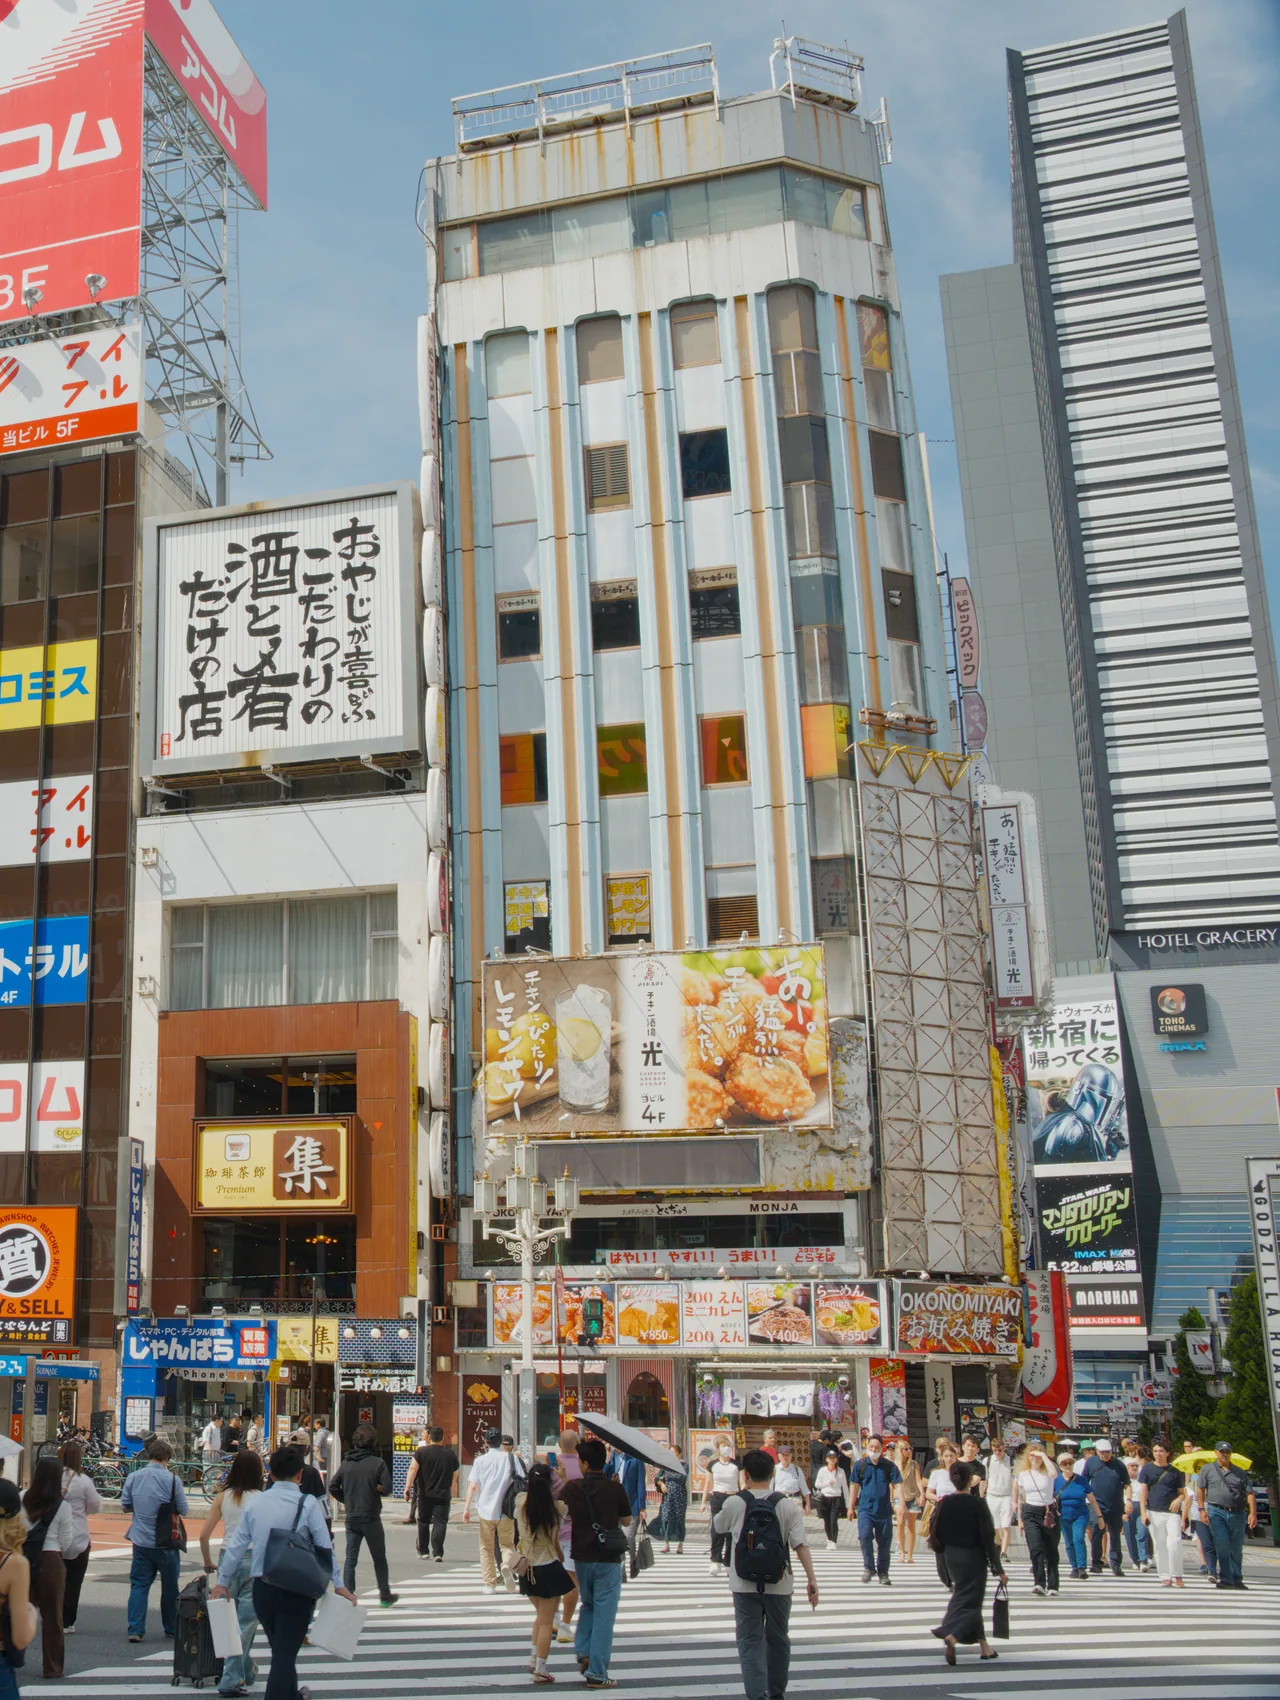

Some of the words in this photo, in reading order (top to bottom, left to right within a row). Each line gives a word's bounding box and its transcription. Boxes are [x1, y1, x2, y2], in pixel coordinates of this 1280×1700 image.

[181, 35, 238, 150] アコム
[61, 333, 127, 368] アイ
[61, 376, 129, 409] フル
[2, 423, 50, 448] 当ビル
[56, 418, 80, 440] 5F
[226, 531, 300, 732] 酒と肴
[298, 547, 341, 725] こだわりの
[174, 569, 230, 743] だけの店
[31, 785, 90, 815] アイ
[30, 824, 91, 854] フル
[506, 886, 545, 900] チキン
[608, 899, 650, 915] レモン
[506, 916, 534, 934] 4F
[608, 918, 651, 933] サワー
[1138, 933, 1194, 949] HOTEL
[1197, 928, 1278, 945] GRACERY
[1006, 968, 1021, 984] 光
[0, 990, 18, 1004] 4F
[723, 966, 746, 1041] チキンが
[646, 992, 657, 1037] チキン酒場
[1159, 1016, 1186, 1025] TOHO
[753, 1000, 784, 1069] 猛烈に
[1027, 1018, 1118, 1049] 新宿に
[1159, 1024, 1196, 1032] CINEMAS
[494, 979, 524, 1122] レモンサワー
[641, 1041, 663, 1067] 光
[1159, 1041, 1206, 1053] IMAX
[1029, 1046, 1121, 1070] 帰ってくる
[641, 1104, 666, 1124] 4F
[204, 1165, 267, 1180] 珈琲茶館
[277, 1135, 336, 1195] 集
[215, 1184, 256, 1195] Premium
[1059, 1190, 1084, 1205] STAR
[1084, 1184, 1112, 1198] WARS
[750, 1203, 799, 1213] MONJA
[1041, 1187, 1131, 1230] マンダロリアン
[127, 1171, 142, 1281] じゃんぱら
[1064, 1216, 1123, 1248] グローグー
[39, 1222, 60, 1255] WATCHES
[610, 1252, 657, 1264] はやい！
[668, 1251, 715, 1263] やすい！
[728, 1249, 777, 1262] うまい！
[795, 1252, 836, 1263] とらそば
[1074, 1250, 1107, 1258] IMAX
[1253, 1196, 1280, 1318] GODZILLA
[45, 1257, 60, 1291] JEWELRY
[496, 1287, 523, 1300] 餃子
[621, 1286, 676, 1297] カツカレー
[684, 1291, 714, 1304] 200
[719, 1291, 743, 1304] えん
[817, 1285, 866, 1298] らーめん
[1039, 1273, 1052, 1315] 大衆酒場
[1076, 1290, 1138, 1306] MARUHAN
[19, 1299, 64, 1315] SELL
[684, 1305, 743, 1318] ミニカレー
[819, 1300, 851, 1309] Ramen
[900, 1292, 1021, 1317] OKONOMIYAKI
[139, 1327, 225, 1338] スマホ・PC・デジタル家電
[243, 1330, 266, 1342] 買取
[685, 1331, 715, 1343] 200
[719, 1331, 745, 1343] えん
[907, 1316, 1012, 1343] お好み焼き
[129, 1337, 234, 1362] じゃんぱら
[243, 1343, 266, 1354] 販売
[310, 1325, 334, 1355] 集
[36, 1367, 58, 1376] SUBNADE
[339, 1375, 417, 1393] 二軒め酒場
[729, 1388, 813, 1411] とらそば
[466, 1408, 497, 1416] Taiyaki
